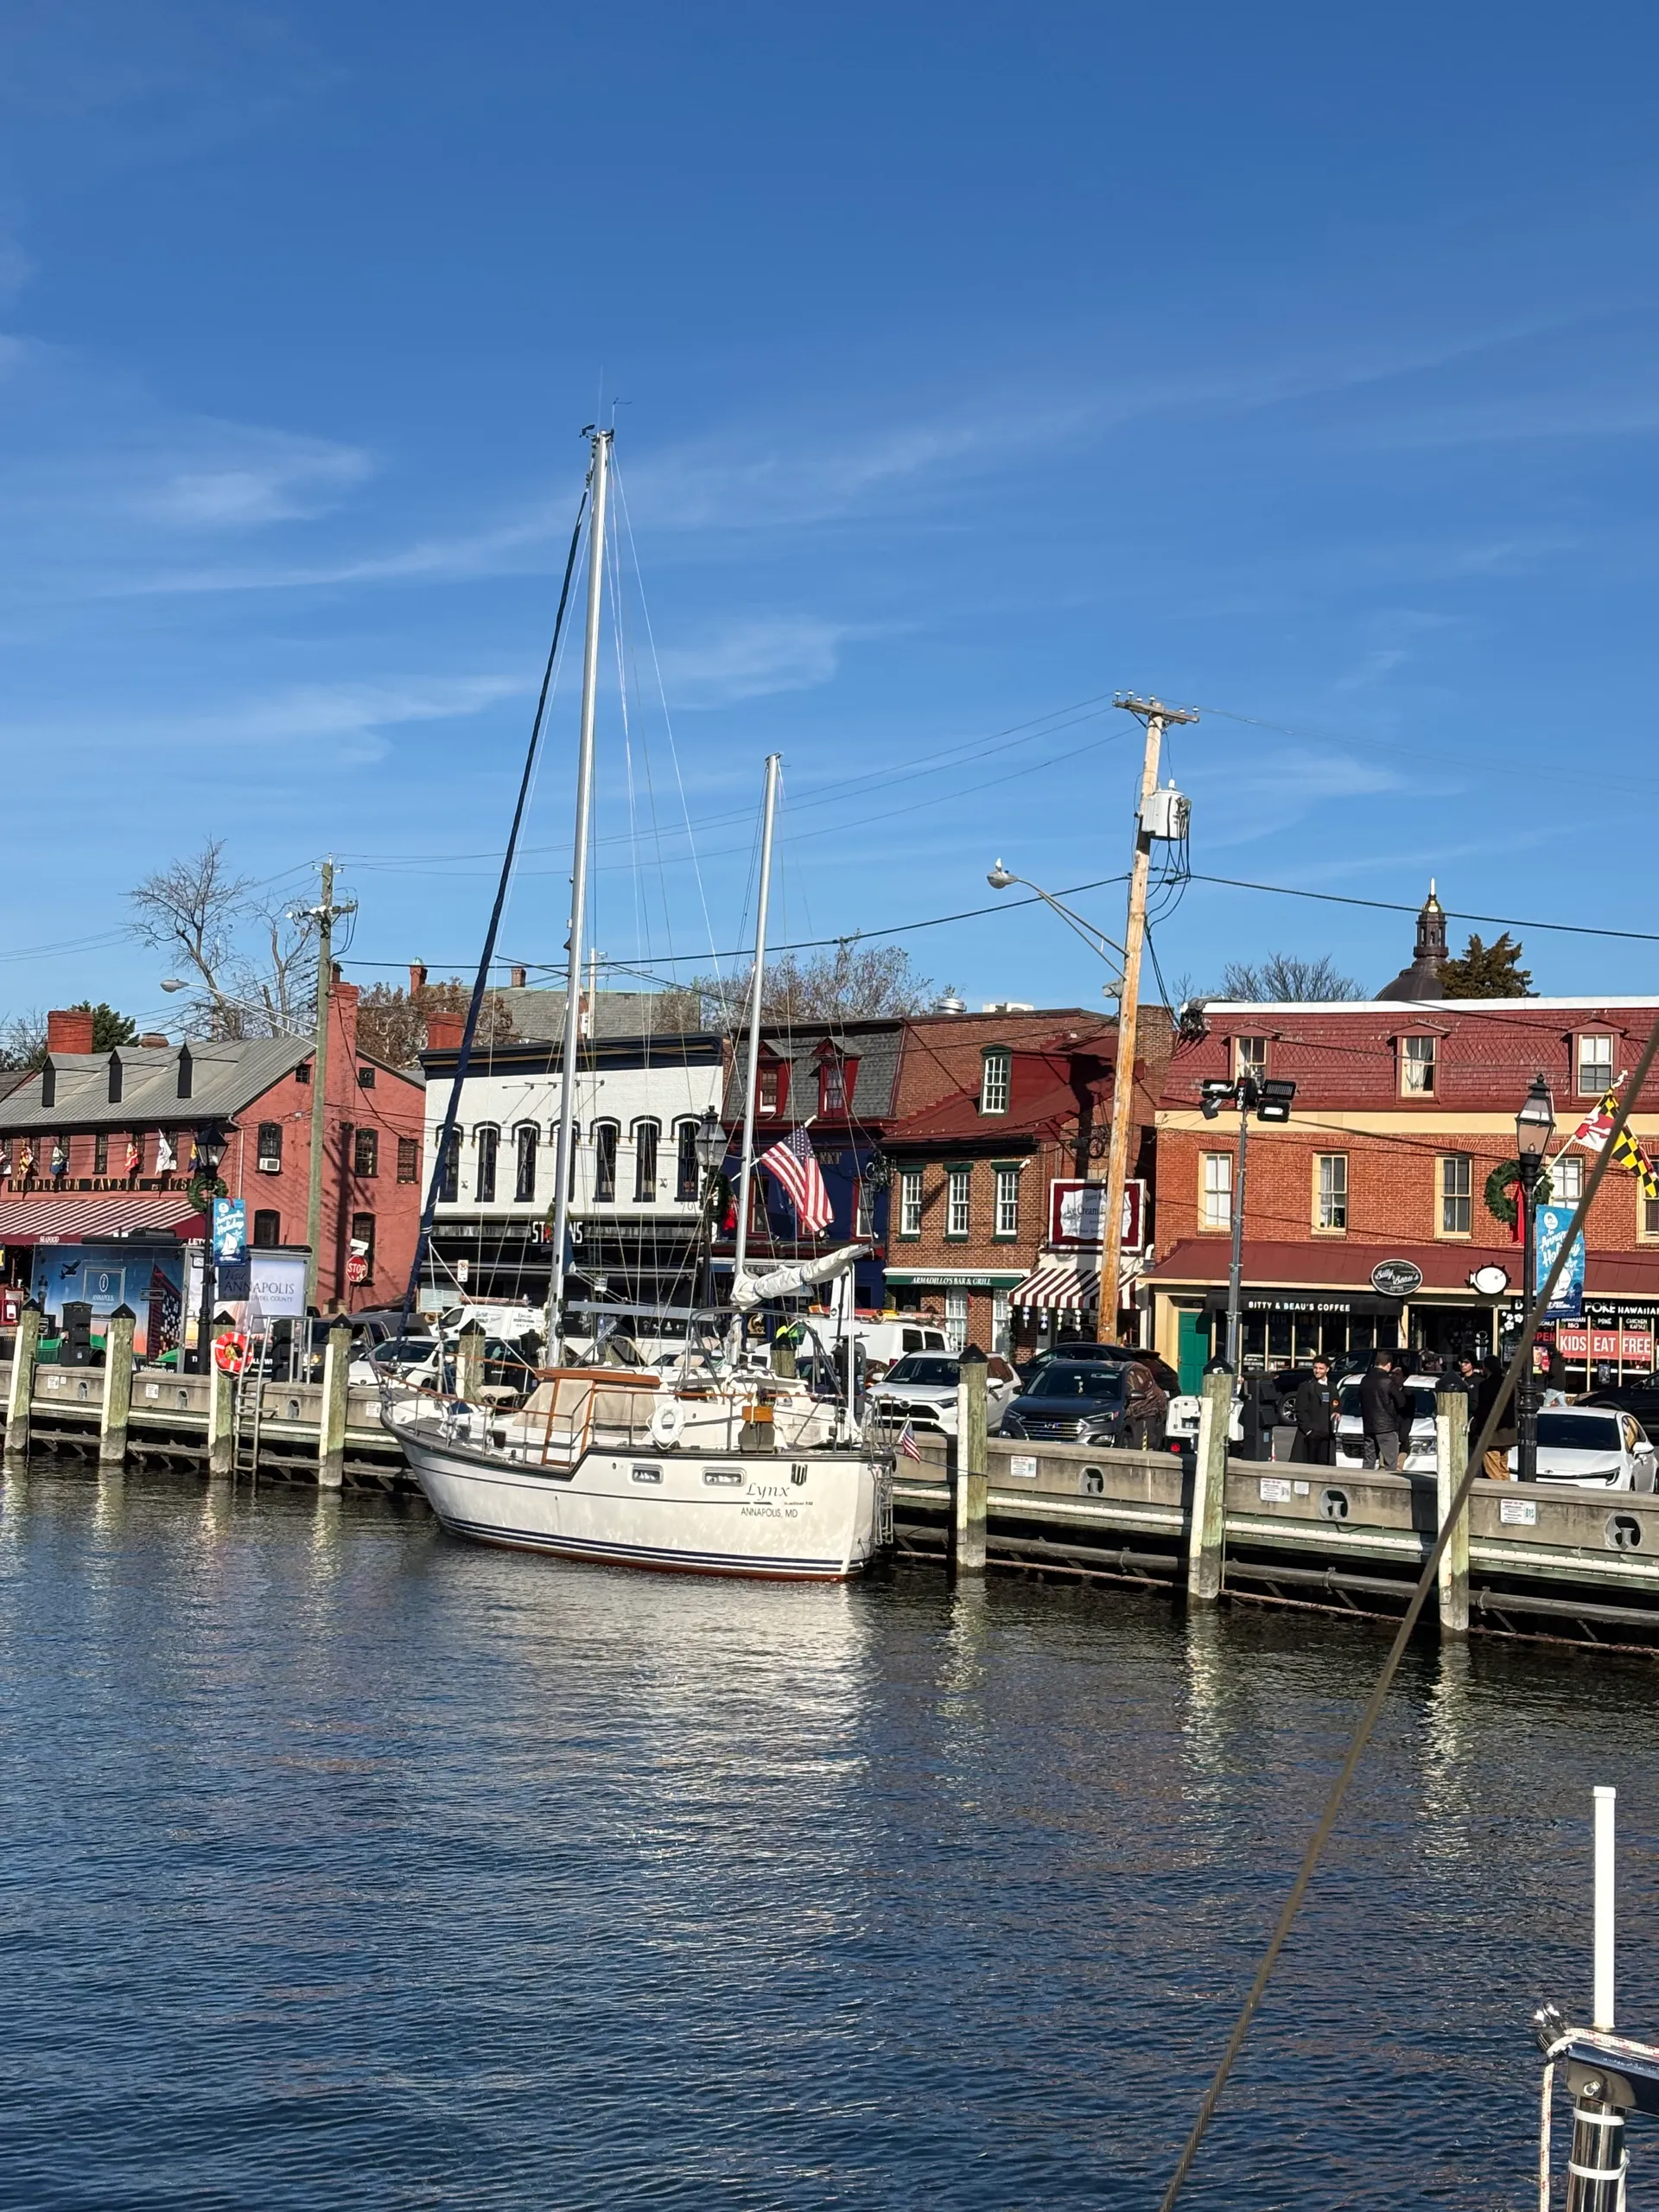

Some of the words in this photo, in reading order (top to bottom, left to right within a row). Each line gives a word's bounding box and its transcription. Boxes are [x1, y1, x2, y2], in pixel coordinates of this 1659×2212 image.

[12, 1179, 79, 1191] MIDDLETON
[90, 1179, 141, 1191] TAVERN
[168, 1179, 193, 1190] 175
[1077, 1204, 1101, 1215] Cream
[531, 1221, 583, 1243] STNS
[1541, 1242, 1581, 1268] Holay
[347, 1262, 366, 1274] STOP
[911, 1276, 953, 1285] ARMADILLO'S
[953, 1277, 967, 1286] BAR
[972, 1277, 992, 1286] GRILL
[225, 1281, 295, 1295] ANNAPOLIS
[1248, 1300, 1273, 1309] BITTY
[1274, 1301, 1281, 1310] &
[1283, 1302, 1314, 1311] BEAU'S
[1317, 1303, 1351, 1313] COFFEE
[1534, 1332, 1555, 1342] PEN
[1560, 1335, 1586, 1351] KIDS
[1593, 1336, 1617, 1352] EAT
[1622, 1338, 1650, 1354] FREE
[746, 1482, 790, 1501] Lynx
[741, 1507, 783, 1519] ANNAPOLIS,
[785, 1509, 798, 1518] MD
